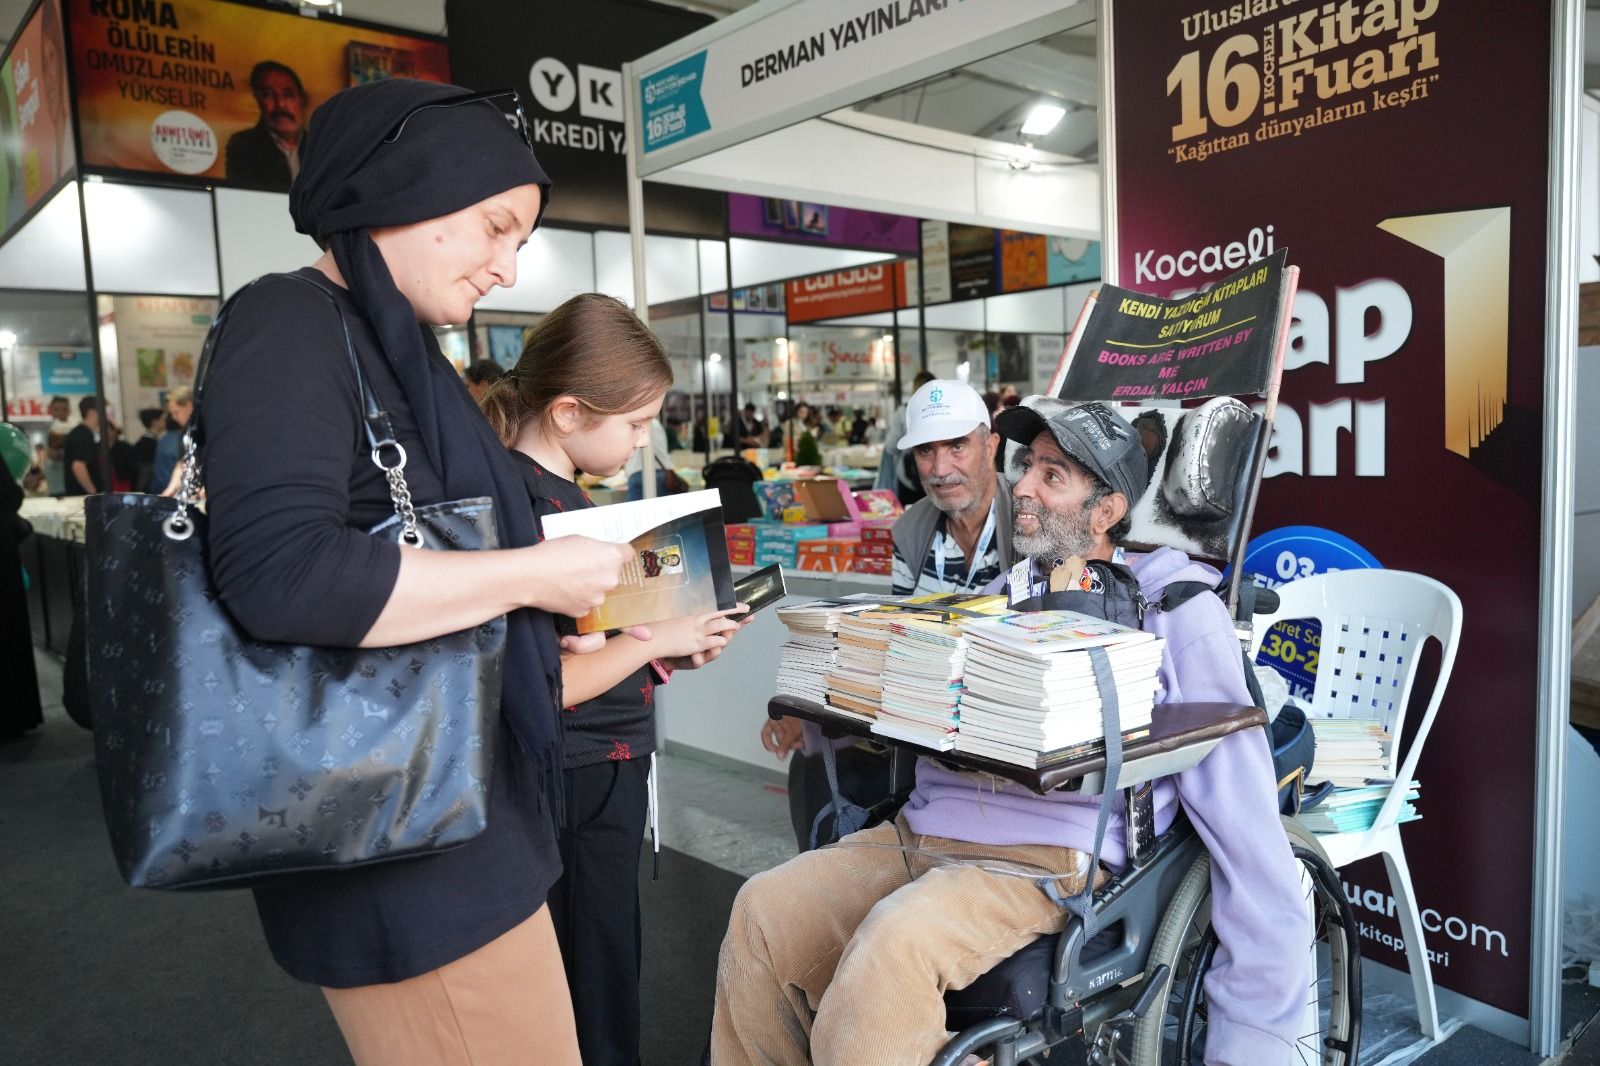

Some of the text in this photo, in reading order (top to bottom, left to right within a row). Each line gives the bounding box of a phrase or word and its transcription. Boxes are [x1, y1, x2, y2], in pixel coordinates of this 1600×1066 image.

[90, 0, 178, 29] ROMA
[1279, 0, 1440, 65] Kitap
[108, 20, 216, 63] ÖLÜLERİN
[741, 0, 948, 88] DERMAN YAYINLARI
[1263, 23, 1275, 99] KOCAELİ
[87, 48, 235, 91] OMUZLARINDA
[1279, 31, 1440, 112] Fuarı
[117, 79, 206, 110] YÜKSELİR
[533, 118, 605, 152] KREDİ
[1255, 100, 1366, 142] dünyaların
[1135, 224, 1275, 285] Kocaeli
[1119, 298, 1164, 320] KENDİ
[1212, 267, 1268, 303] KİTAPLARI
[1158, 308, 1222, 339] SATIYORUM
[1097, 328, 1254, 366] BOOKS ARE WRITTEN BY
[1113, 377, 1209, 397] ERDAL YALÇIN
[1157, 366, 1181, 379] ME
